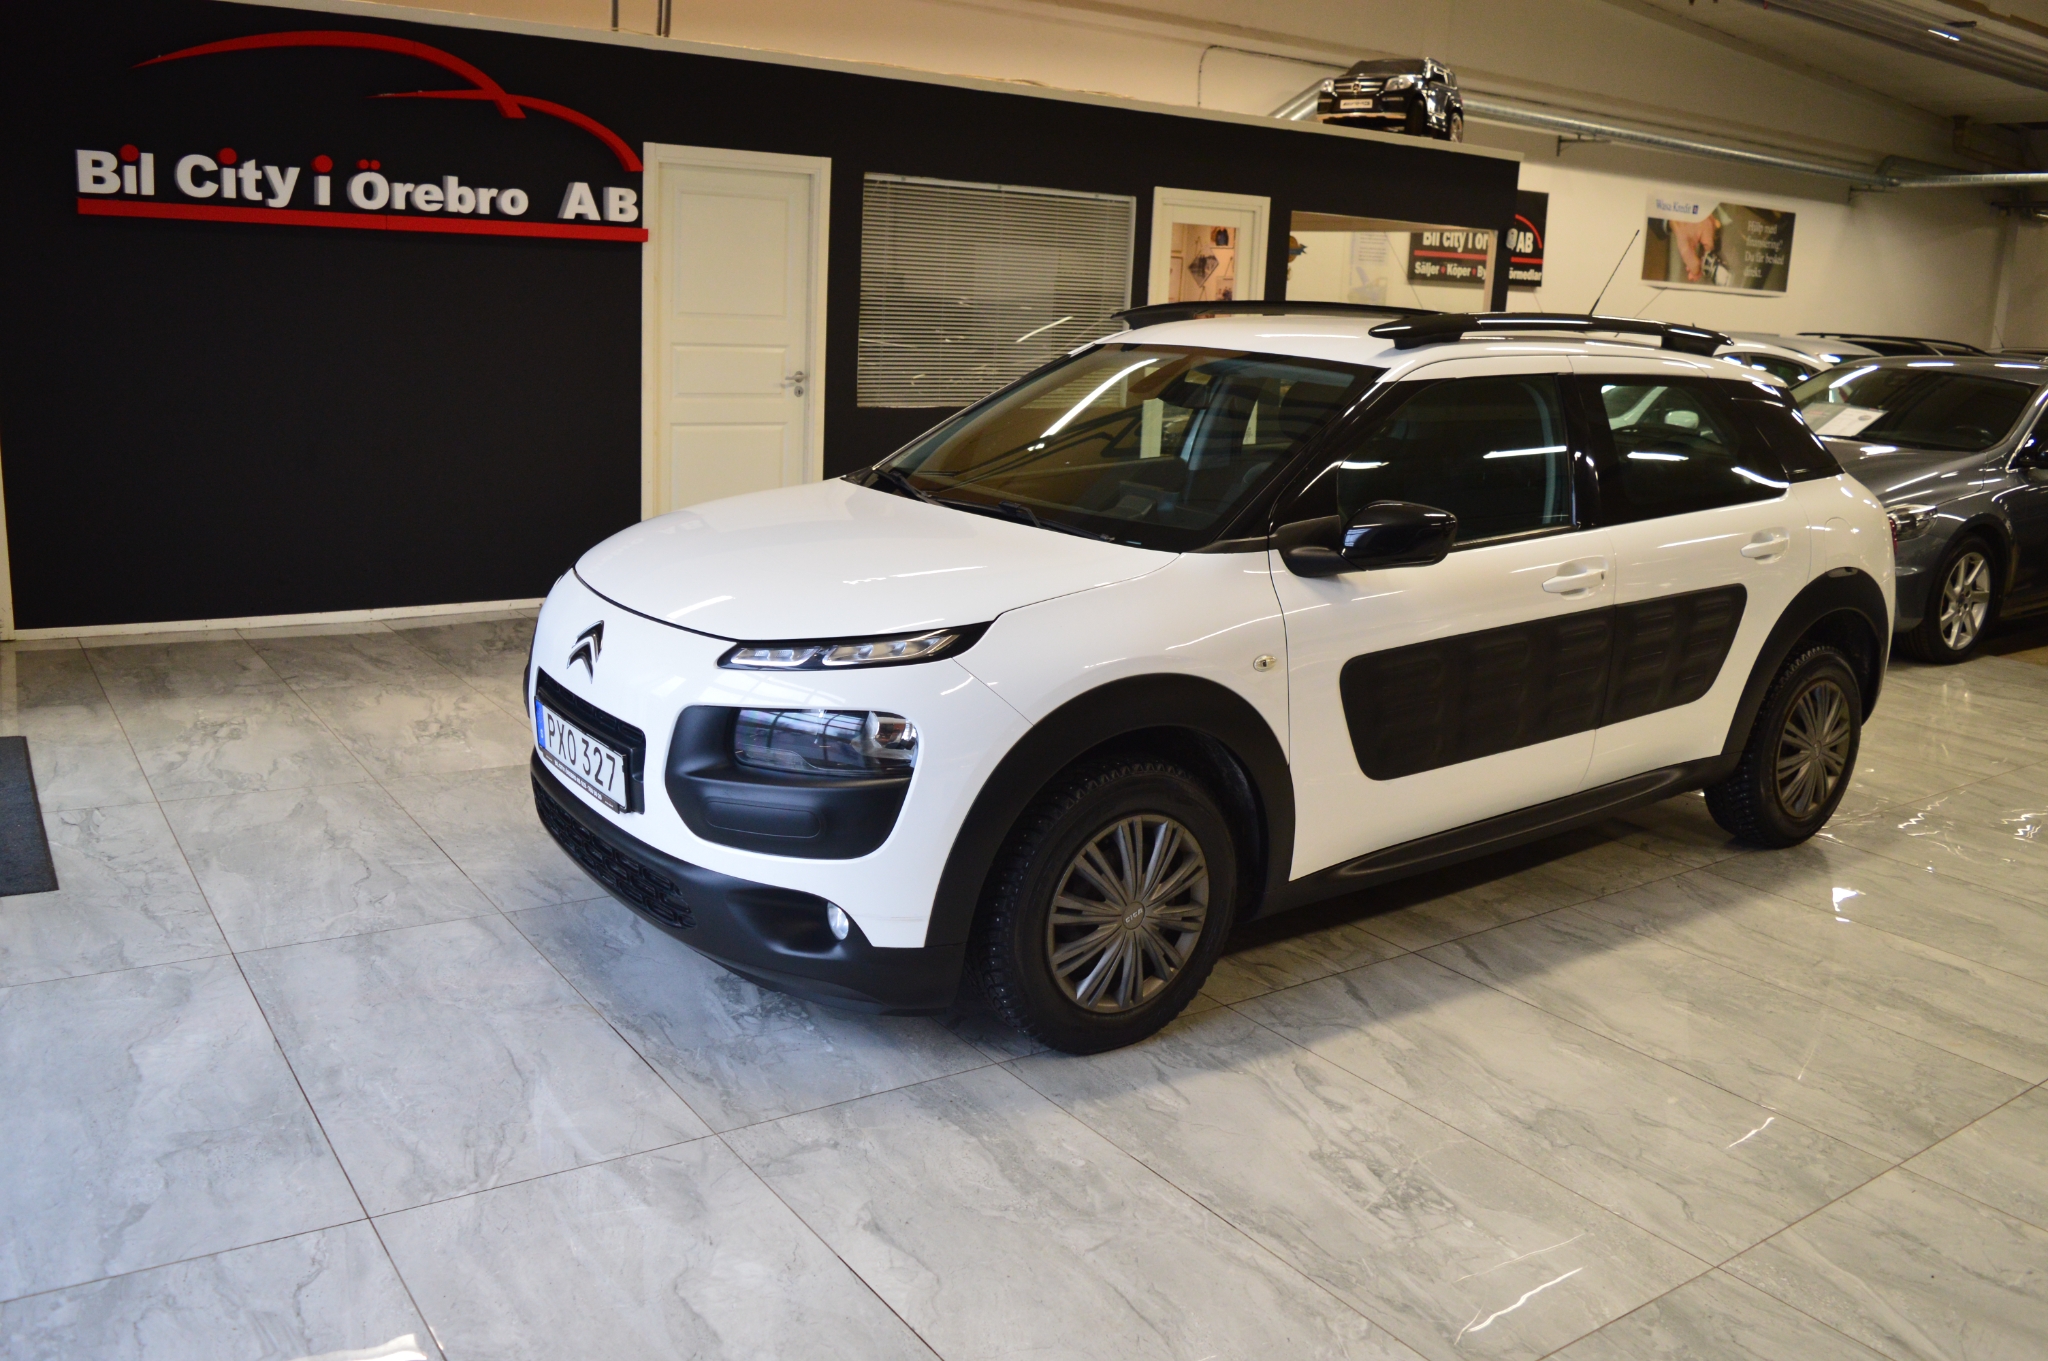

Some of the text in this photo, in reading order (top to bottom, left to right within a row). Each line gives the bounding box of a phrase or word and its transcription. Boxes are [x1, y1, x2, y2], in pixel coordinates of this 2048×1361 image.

[76, 144, 640, 223] Bil City i Örebro AB
[1415, 262, 1439, 277] Säljer
[1447, 264, 1471, 278] Köper
[1509, 267, 1542, 280] örmedlar
[547, 713, 616, 792] PXO 327
